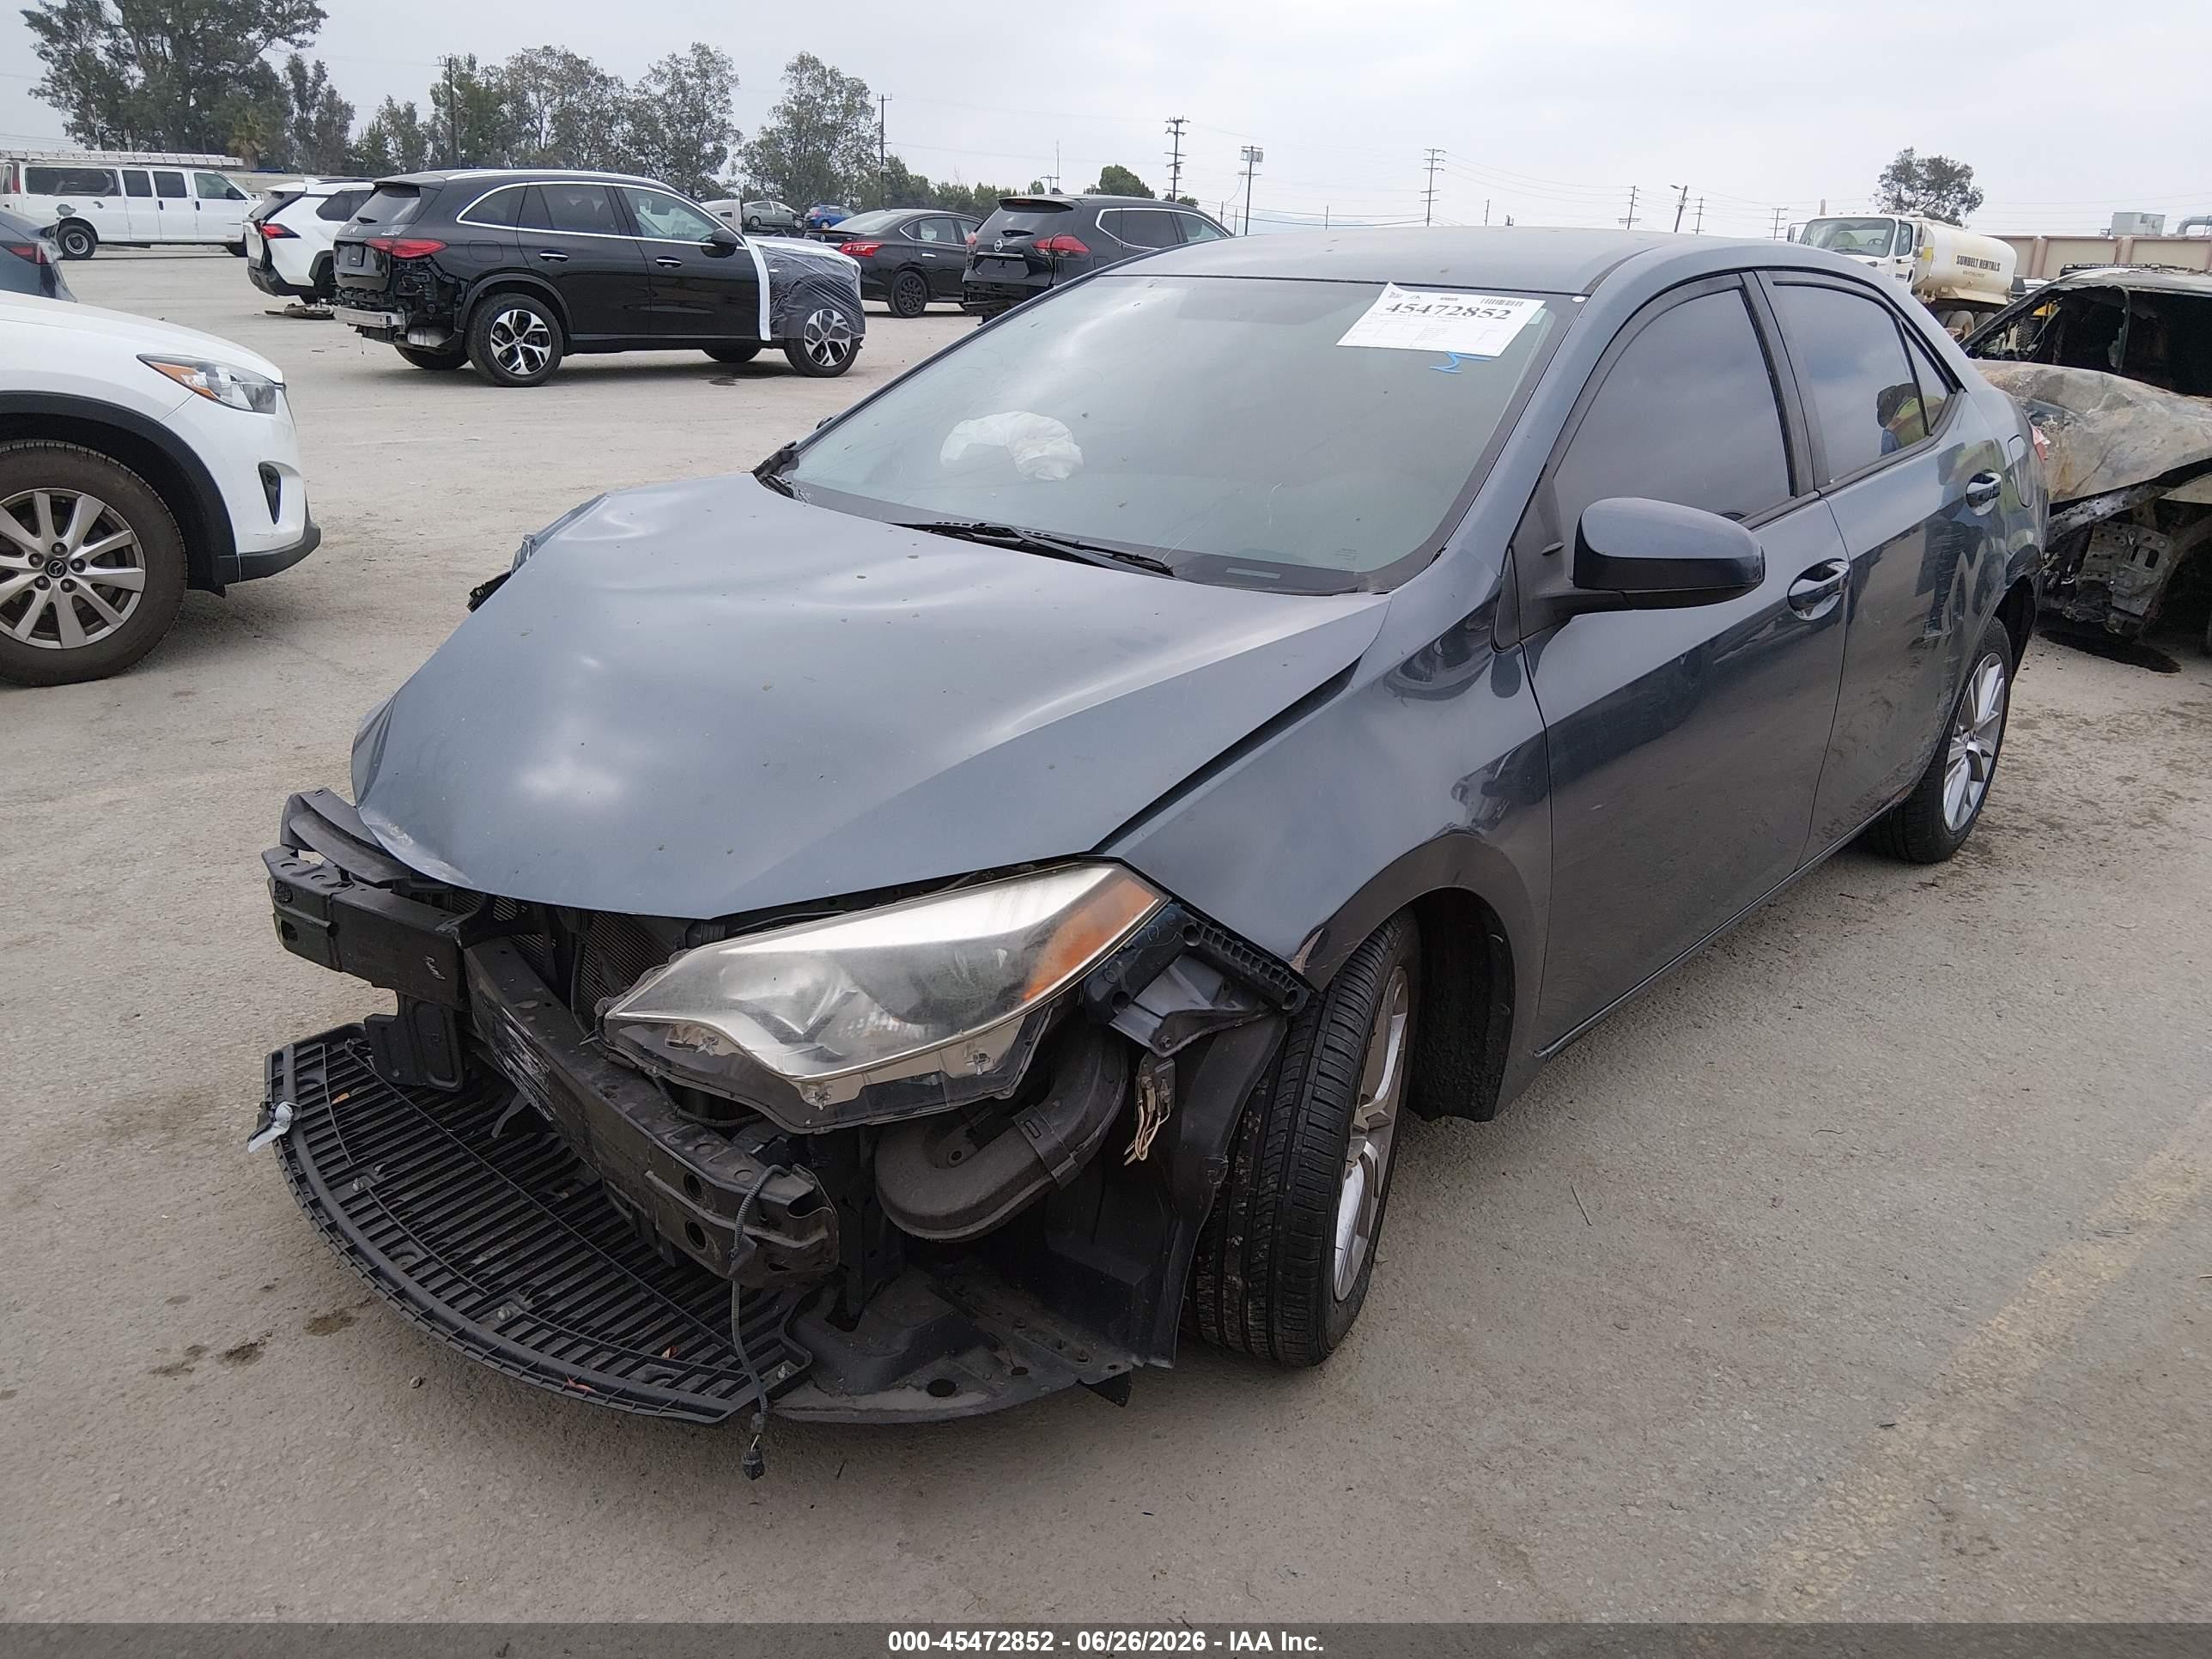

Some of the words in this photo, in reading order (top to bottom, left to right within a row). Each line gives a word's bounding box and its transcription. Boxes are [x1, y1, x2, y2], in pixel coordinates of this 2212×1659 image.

[1956, 255, 1978, 268] SUNBELT
[1978, 259, 2001, 271] RENTALS
[1386, 302, 1512, 319] 45472852
